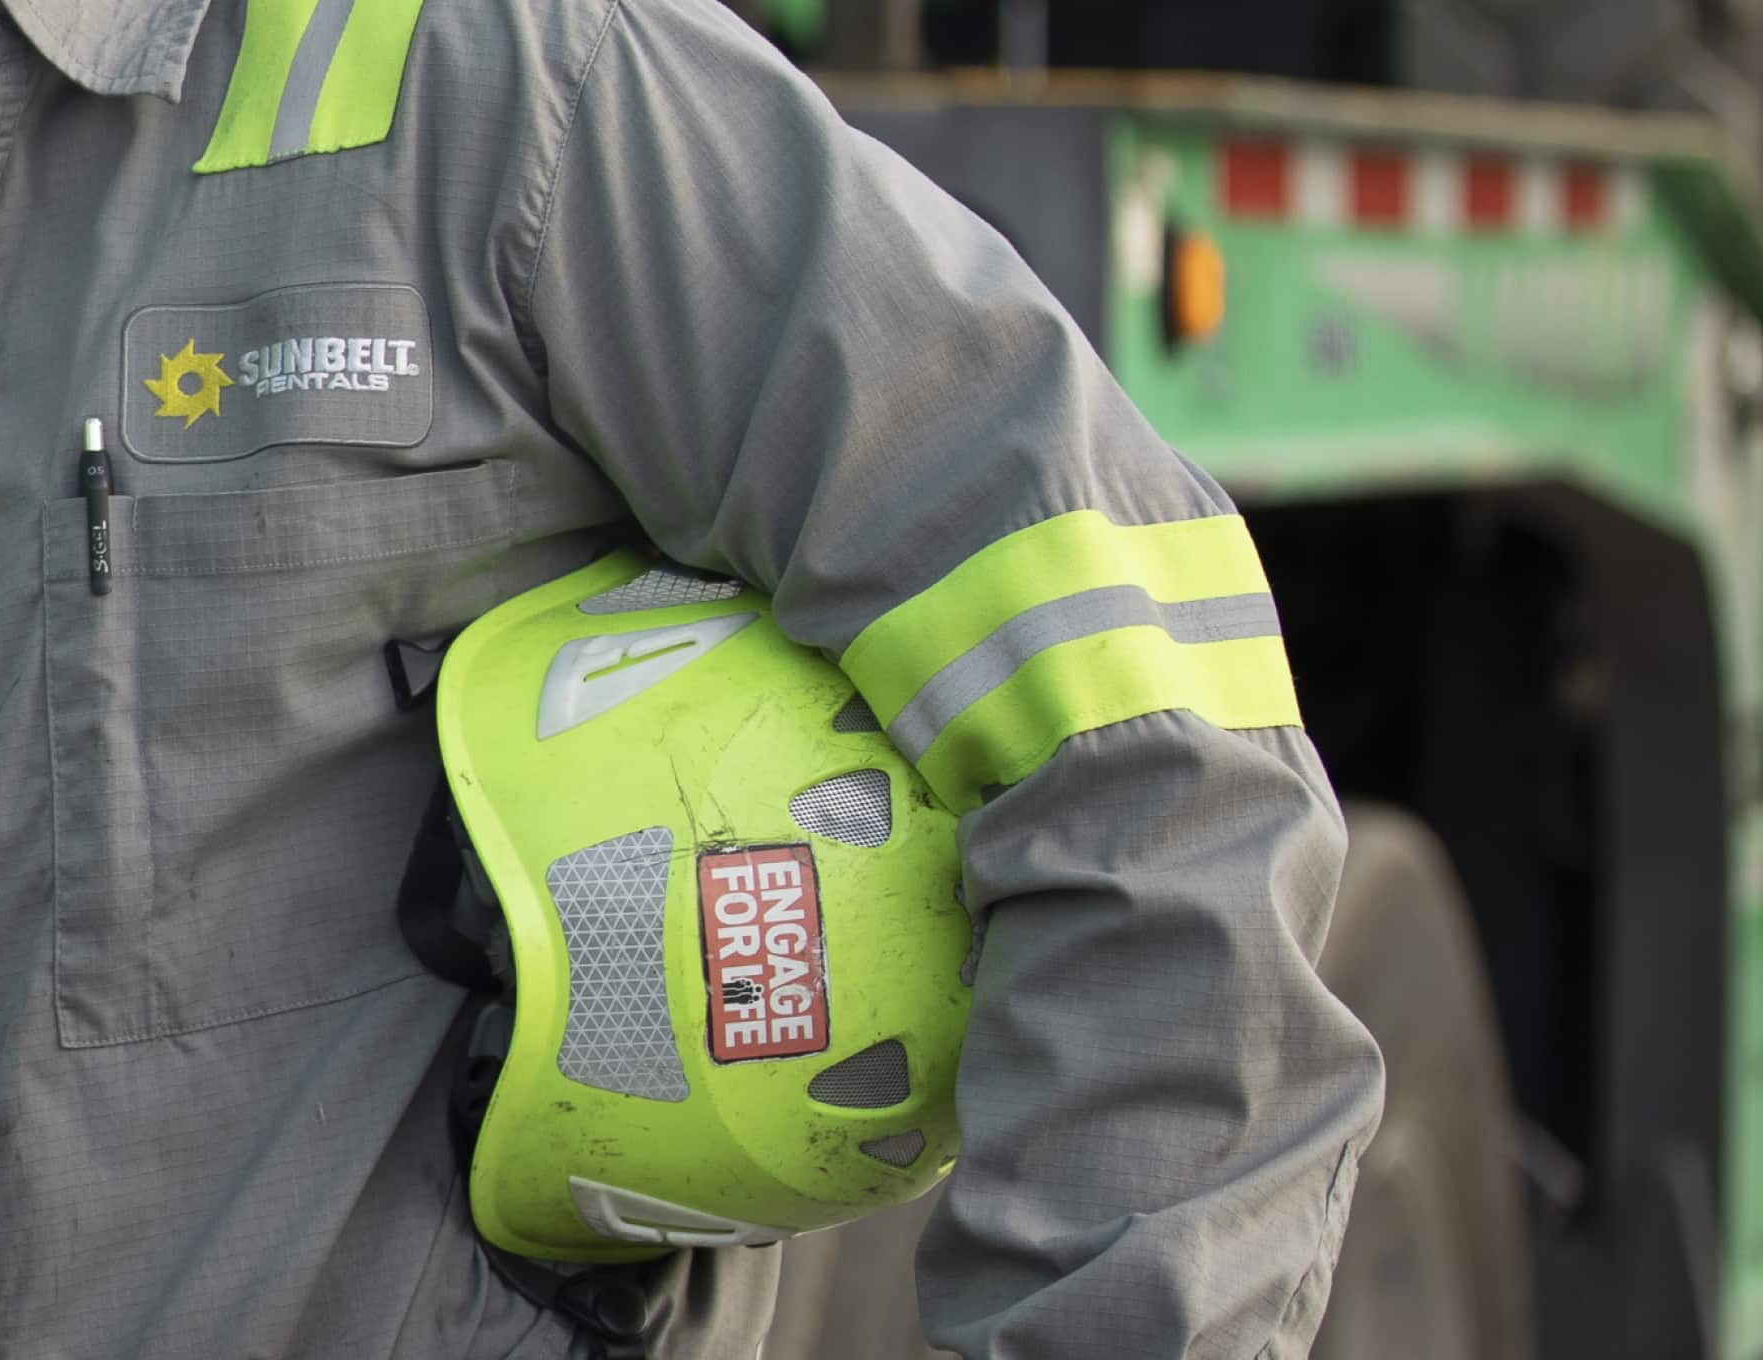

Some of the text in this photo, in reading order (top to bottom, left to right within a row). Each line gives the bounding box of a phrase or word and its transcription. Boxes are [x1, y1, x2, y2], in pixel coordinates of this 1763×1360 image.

[255, 372, 389, 400] RENTALS
[711, 864, 767, 1048] FOR LFE
[757, 860, 814, 1044] ENGAGE
